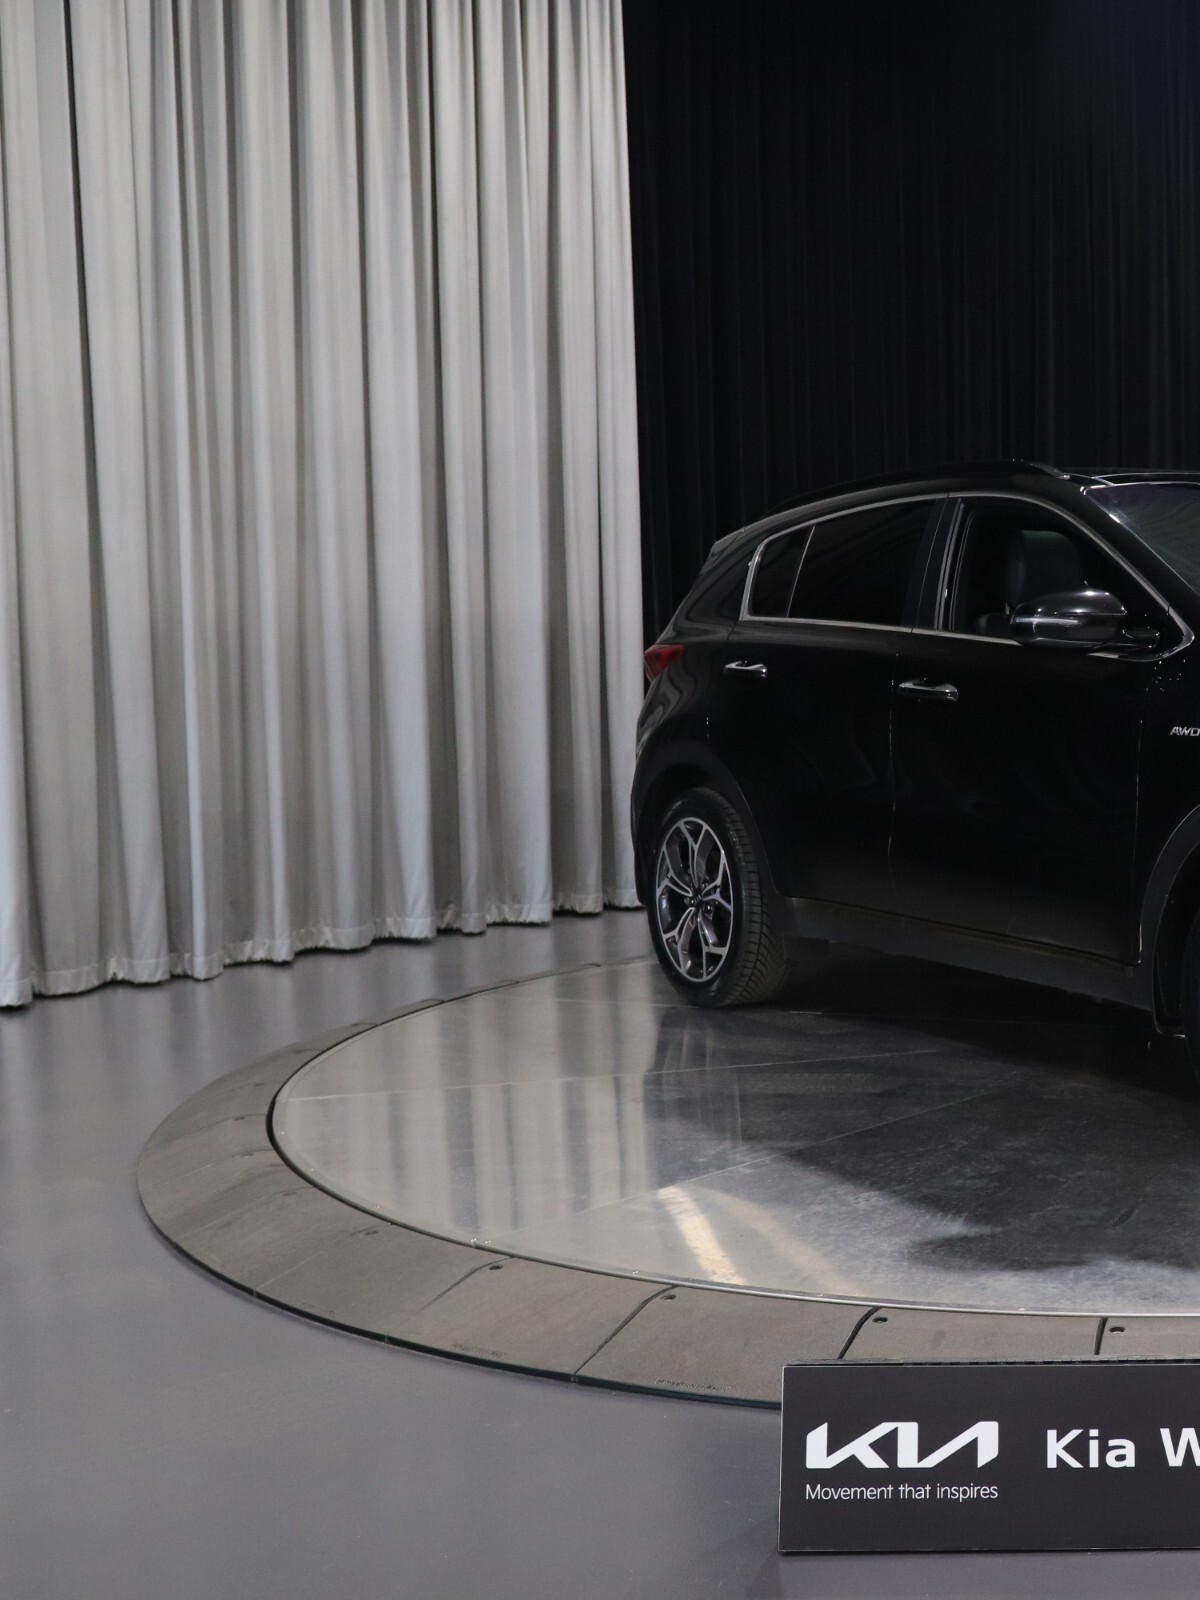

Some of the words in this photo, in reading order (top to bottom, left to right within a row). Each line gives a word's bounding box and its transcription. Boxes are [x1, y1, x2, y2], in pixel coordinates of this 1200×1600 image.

[1169, 726, 1200, 737] AWD
[805, 1420, 1000, 1470] KIA
[1046, 1428, 1136, 1469] Kia
[805, 1483, 894, 1500] Movement
[897, 1482, 932, 1499] that
[936, 1482, 999, 1503] inspires
